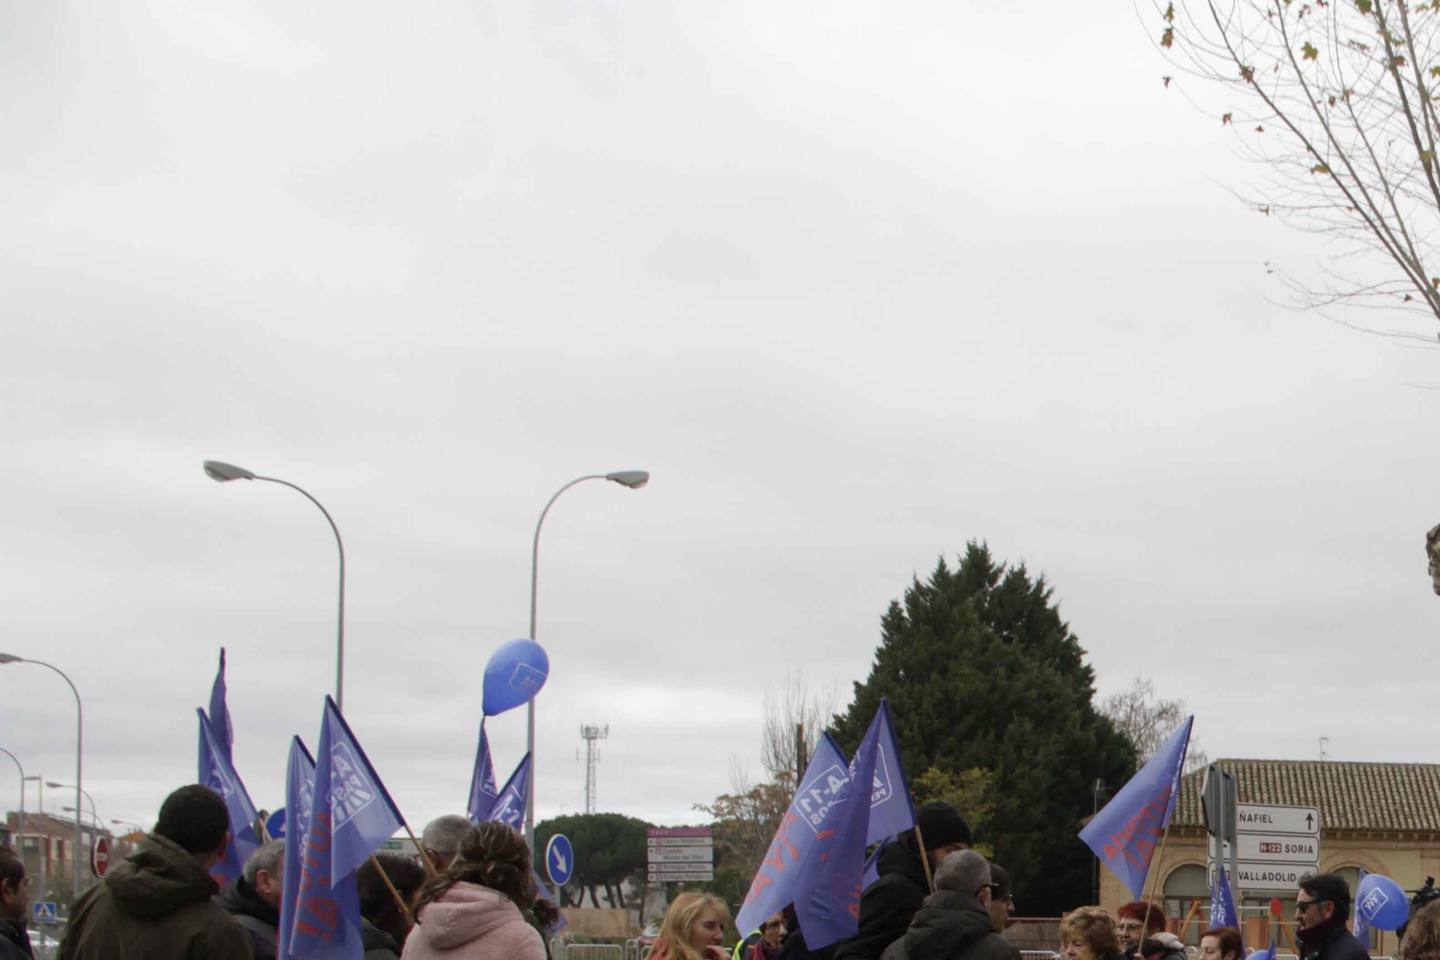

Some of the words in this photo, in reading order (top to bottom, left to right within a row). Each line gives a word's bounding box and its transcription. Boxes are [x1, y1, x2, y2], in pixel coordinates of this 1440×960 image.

[1239, 811, 1273, 824] ÑAFIEL
[1260, 843, 1281, 853] N-122
[1284, 844, 1314, 854] SORIA
[1238, 871, 1297, 882] VALLADOLID
